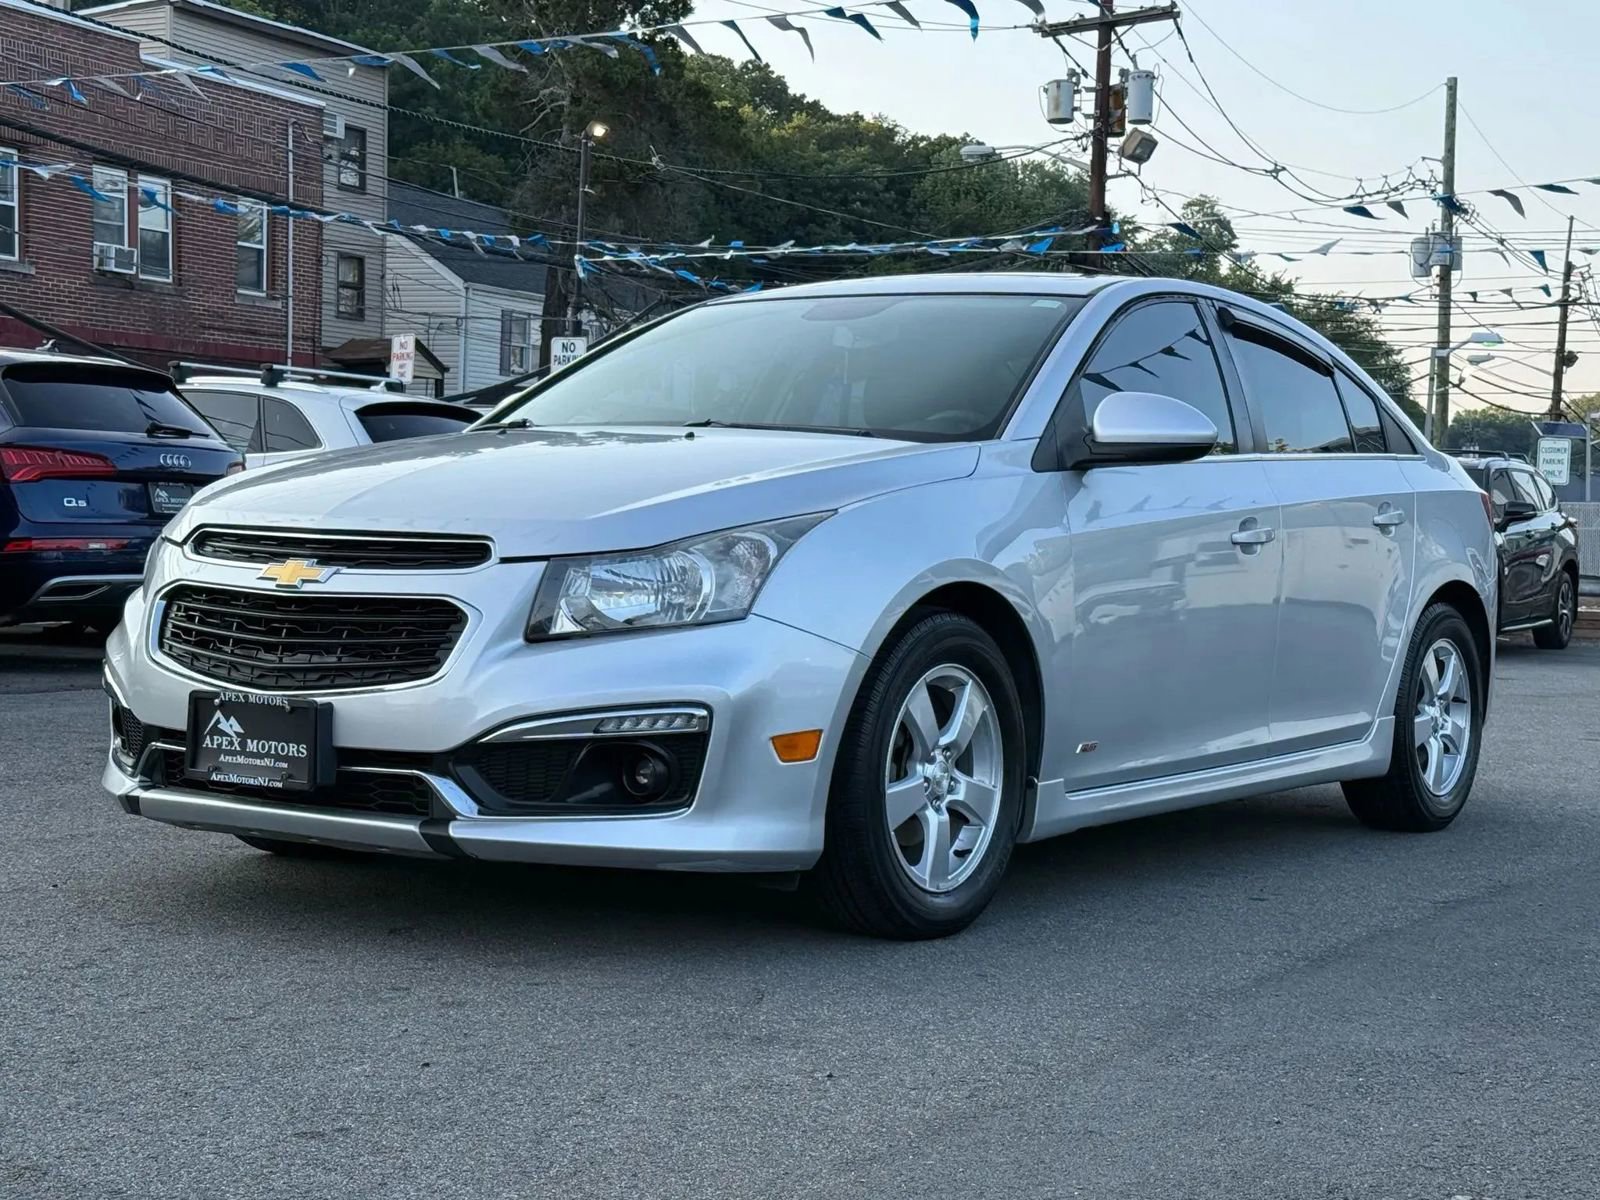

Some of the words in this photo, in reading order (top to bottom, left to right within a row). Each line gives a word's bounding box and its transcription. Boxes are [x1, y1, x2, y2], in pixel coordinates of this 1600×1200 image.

[400, 341, 408, 350] NO
[561, 342, 576, 353] NO
[553, 354, 583, 366] PARKIN
[1542, 457, 1565, 465] PARKING
[1543, 469, 1563, 477] ONLY
[63, 497, 87, 507] Q5
[219, 691, 245, 703] APEX
[249, 694, 288, 707] MOTORS
[202, 735, 241, 751] APEX
[246, 739, 307, 758] MOTORS
